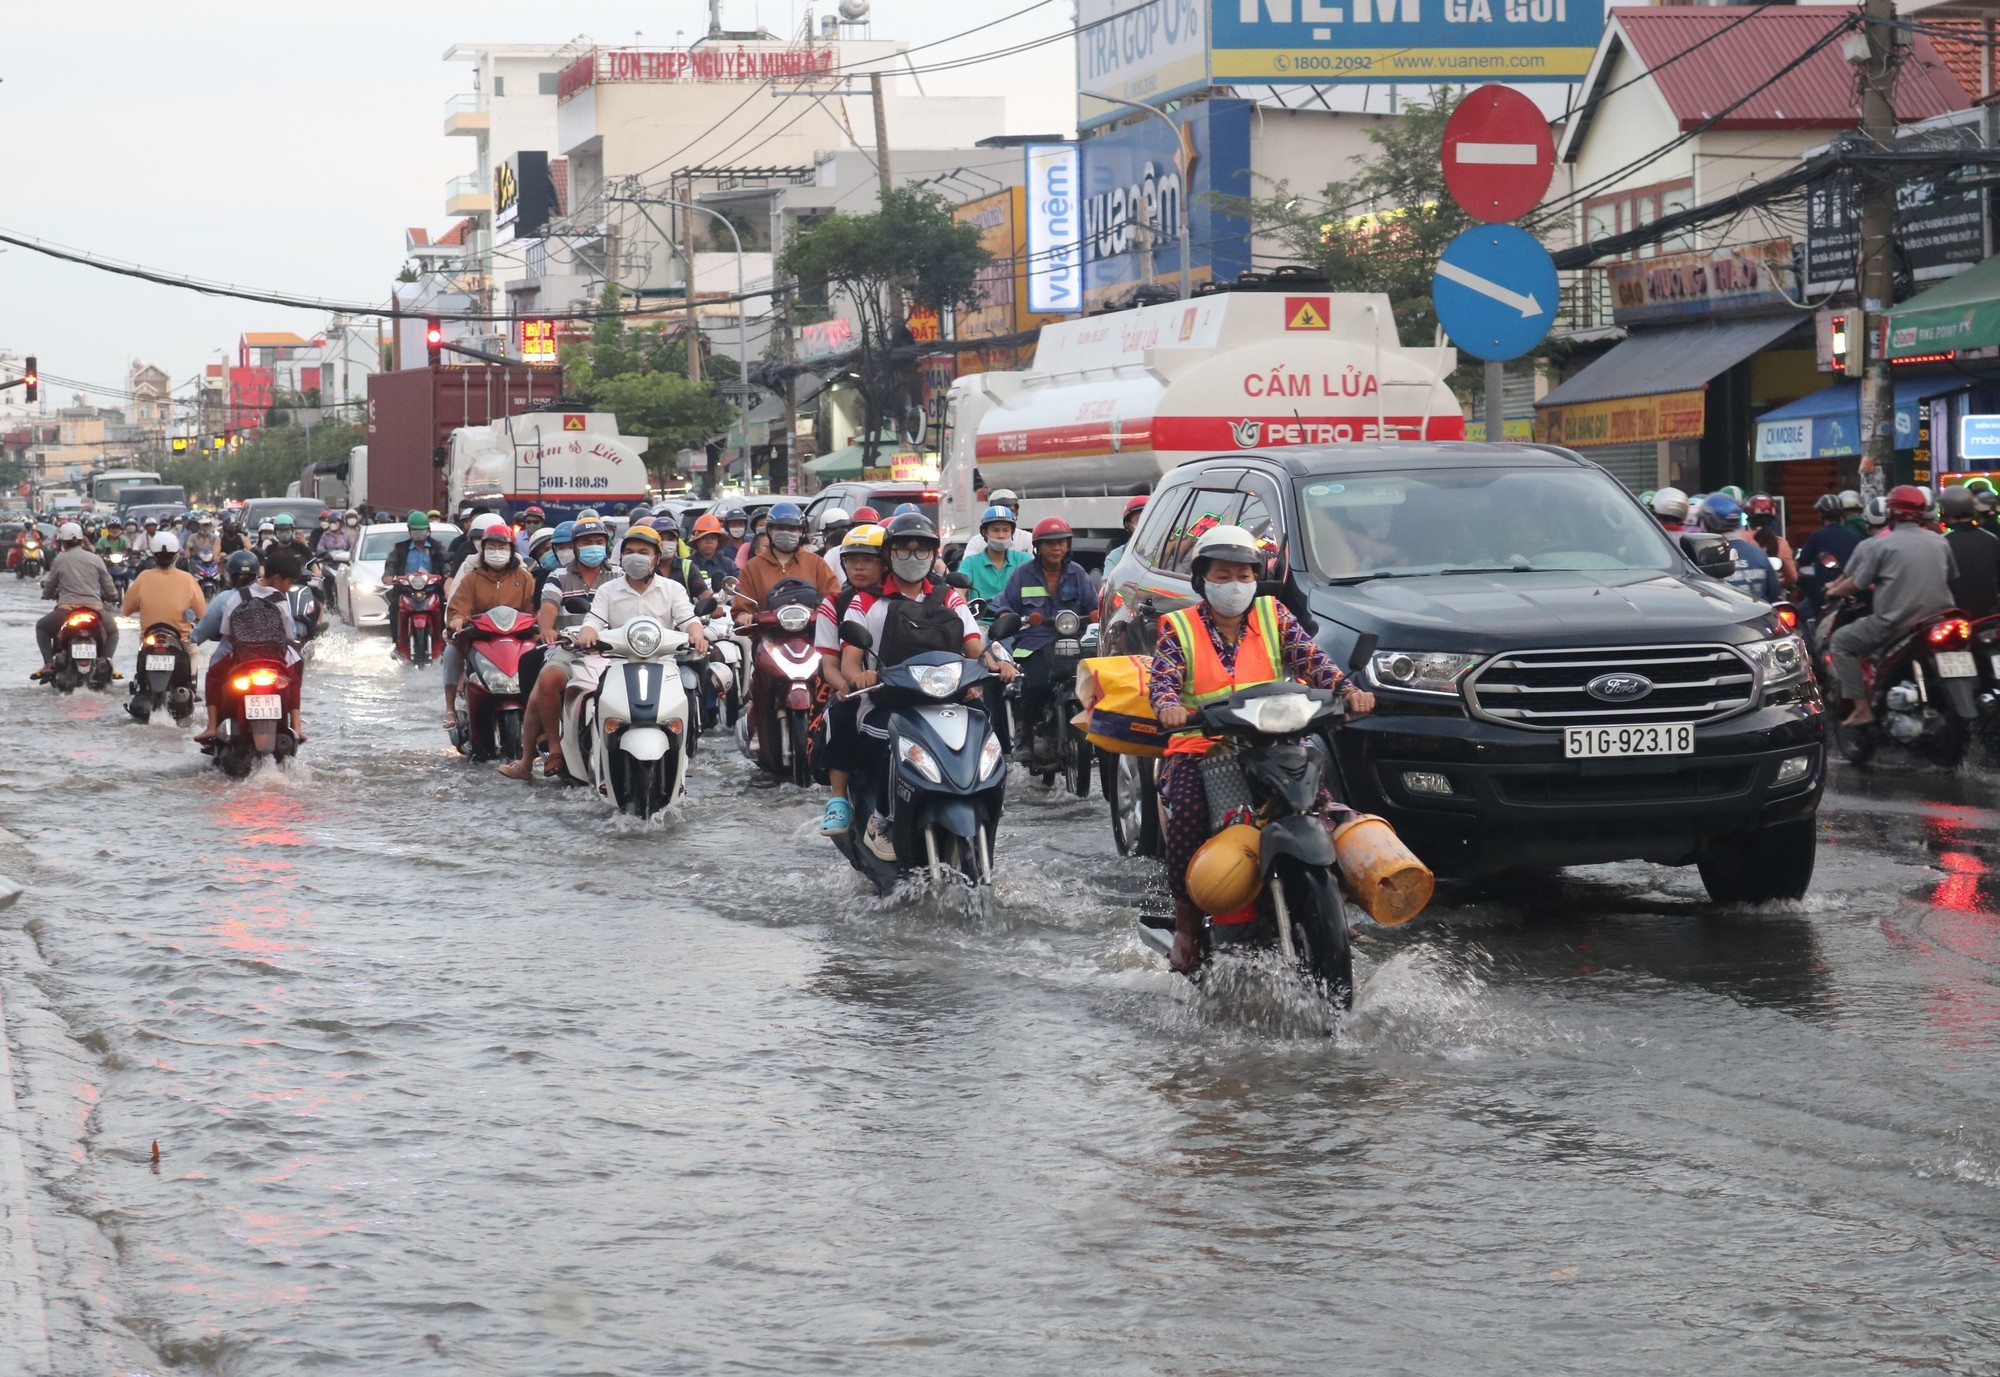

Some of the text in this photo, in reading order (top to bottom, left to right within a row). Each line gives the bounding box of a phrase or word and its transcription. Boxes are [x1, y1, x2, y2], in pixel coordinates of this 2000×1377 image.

[1294, 53, 1545, 70] 1800.2092 www.vuanem.com
[1041, 165, 1074, 302] vua nệm
[1243, 364, 1379, 398] CẤM LỬA
[1268, 423, 1353, 443] PETRO
[539, 476, 609, 488] 50H-180.89
[1604, 678, 1638, 694] Ford
[250, 696, 275, 707] 65-H1
[248, 707, 280, 718] 291.18
[1569, 726, 1690, 755] 51G-923.18
